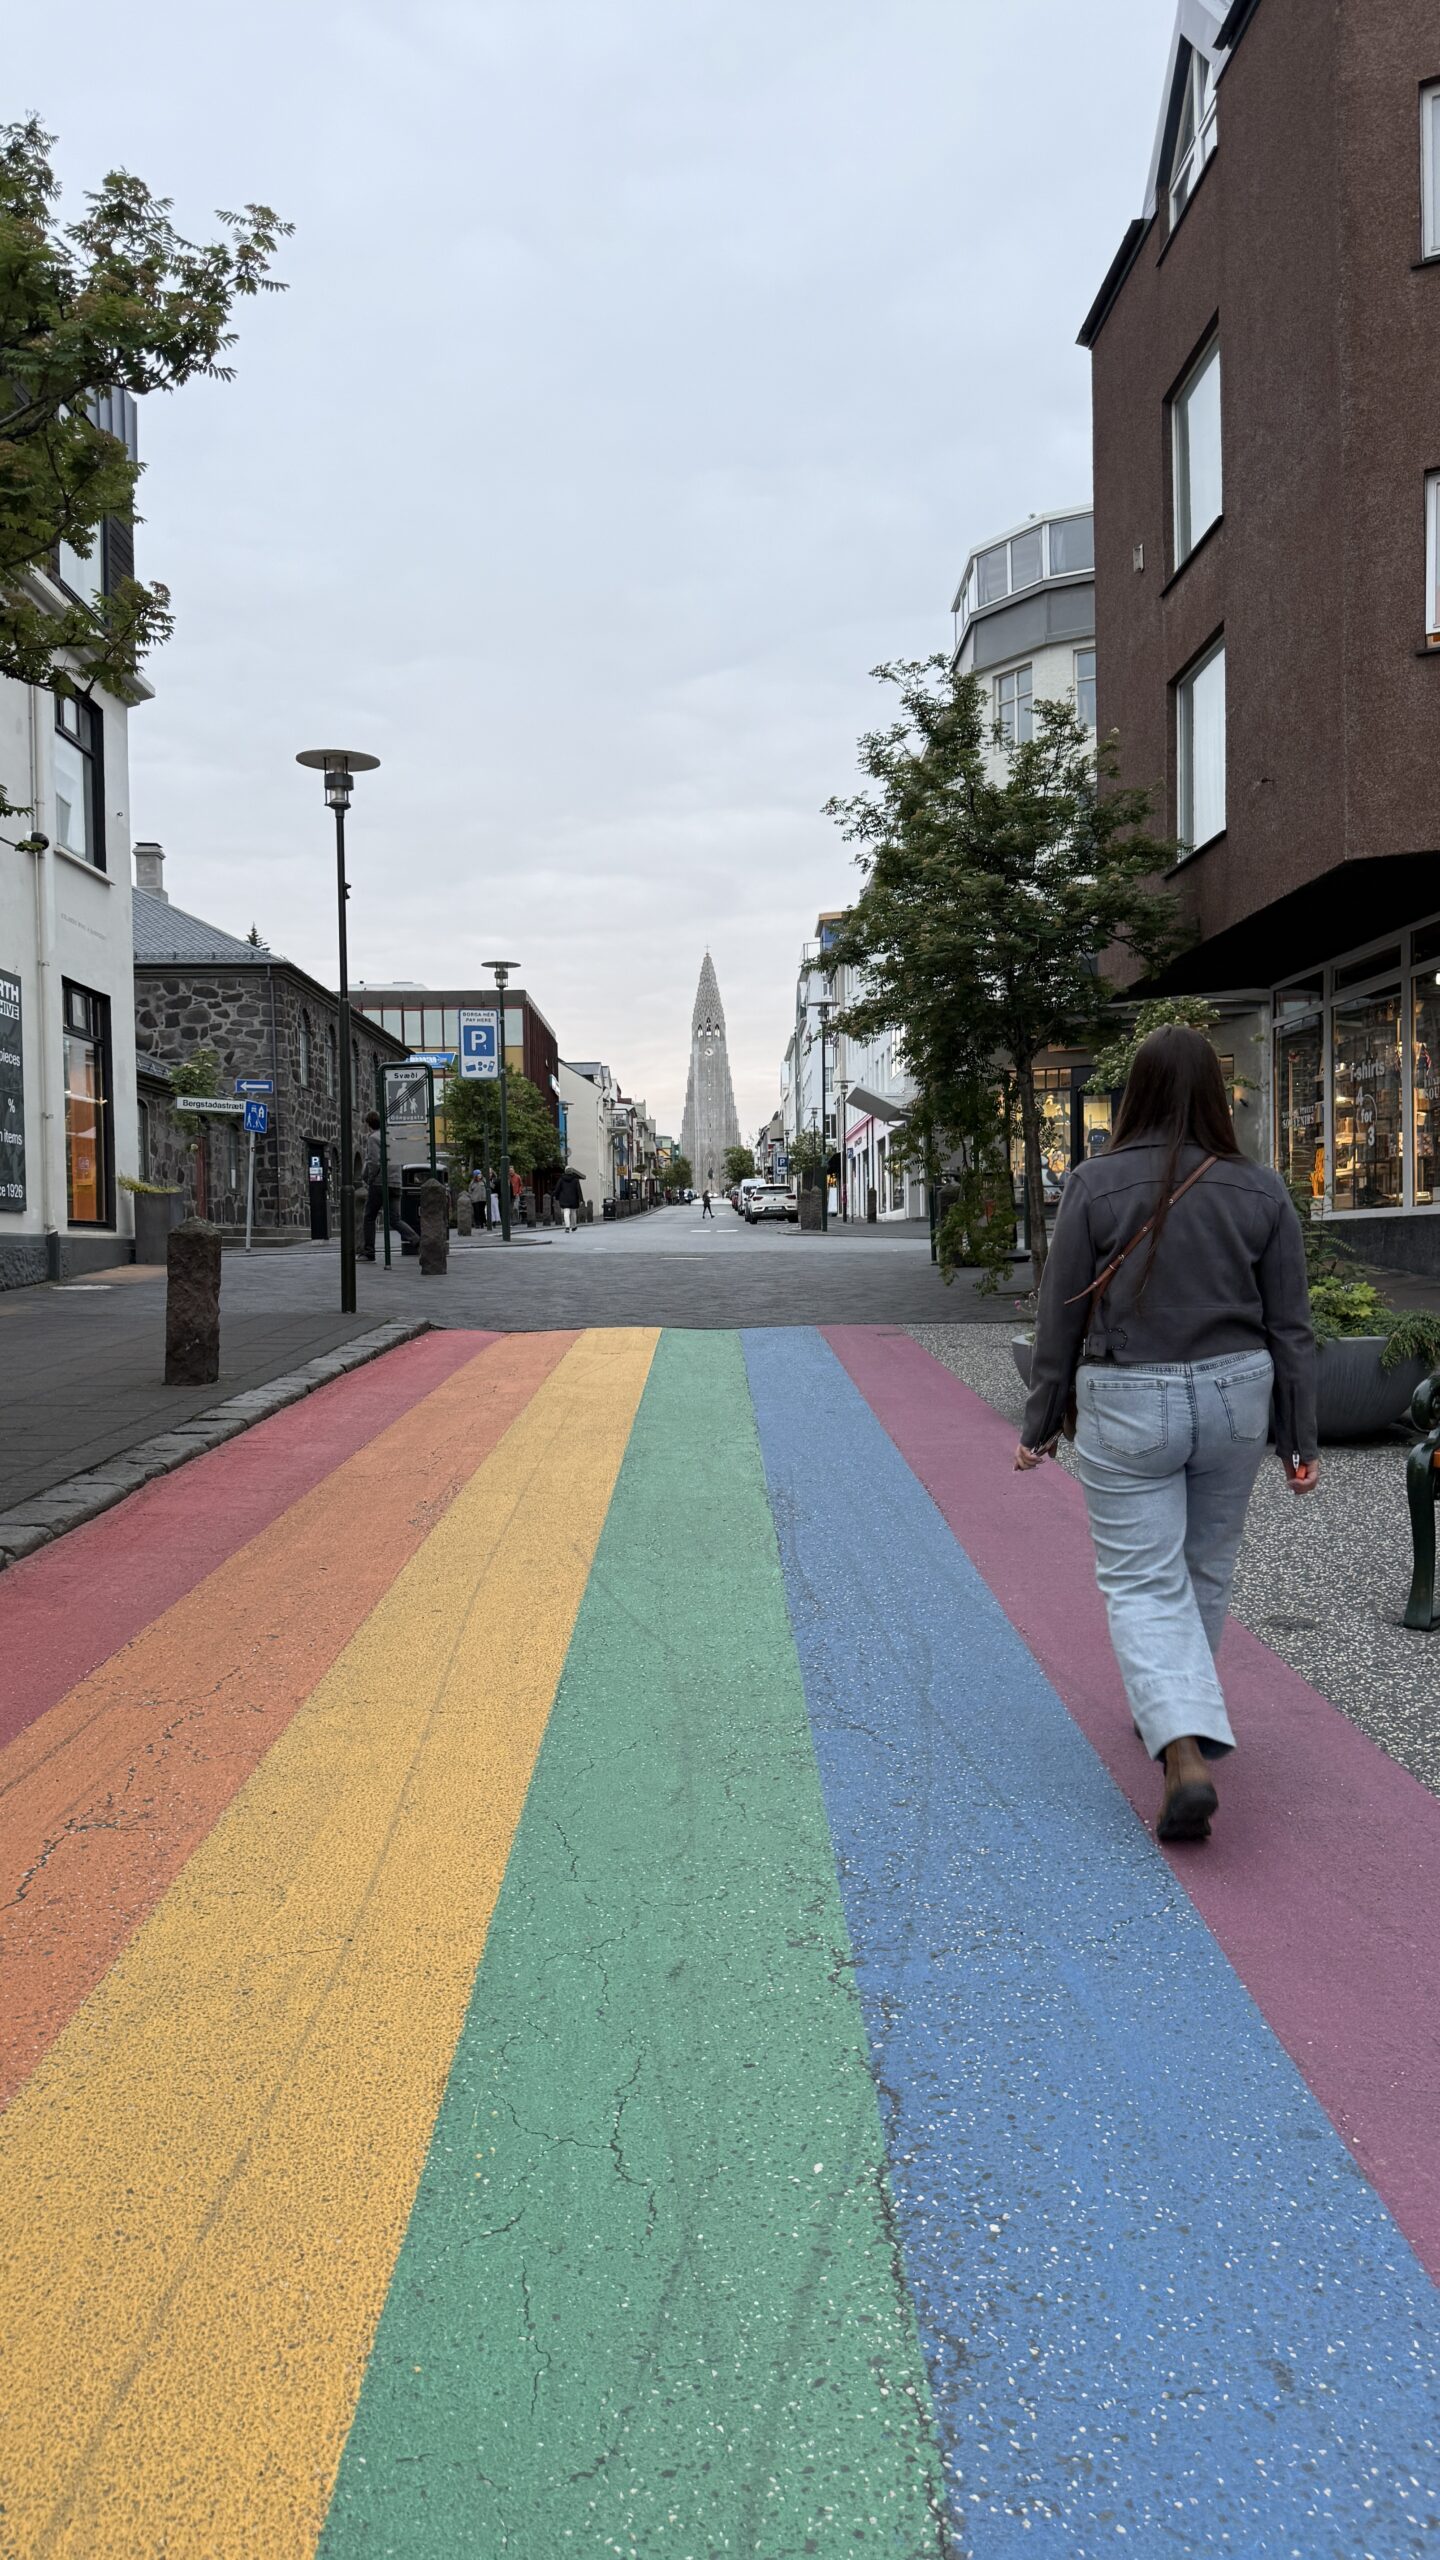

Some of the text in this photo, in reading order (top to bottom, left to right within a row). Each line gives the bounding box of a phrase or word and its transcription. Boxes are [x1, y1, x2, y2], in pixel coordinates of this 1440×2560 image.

[471, 1031, 487, 1052] P
[182, 1099, 244, 1111] Bergstaðastræti
[1361, 1108, 1373, 1123] for
[3, 1128, 23, 1145] items
[7, 1183, 23, 1199] 1926
